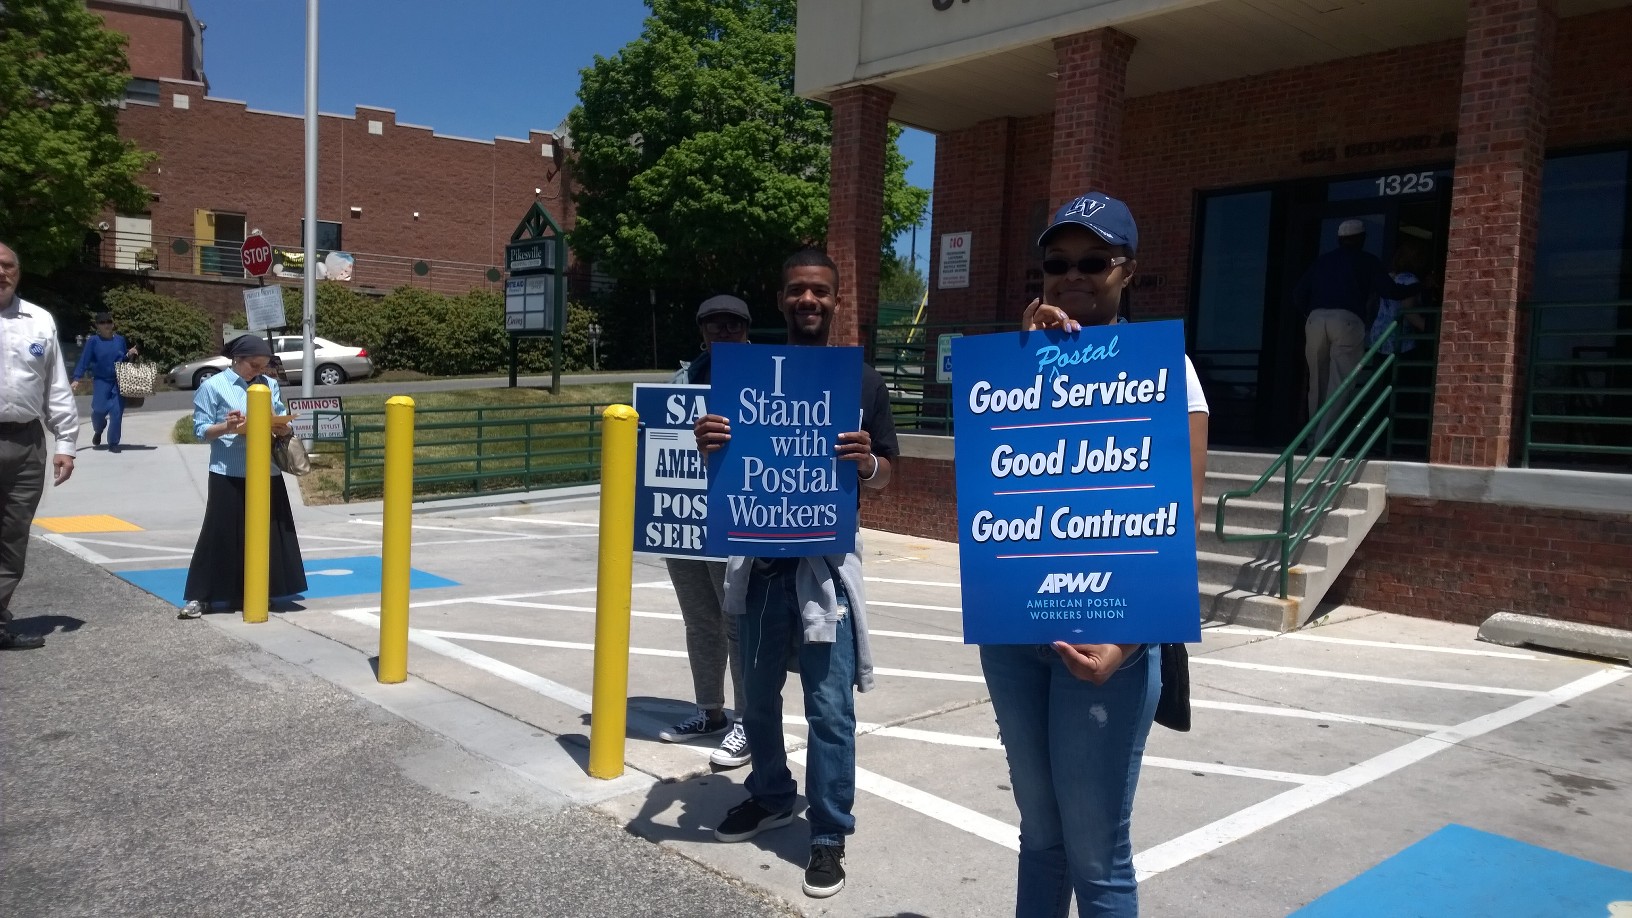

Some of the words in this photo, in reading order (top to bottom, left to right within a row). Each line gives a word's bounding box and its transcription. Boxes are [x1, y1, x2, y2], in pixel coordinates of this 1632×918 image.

[1376, 171, 1434, 196] 1325
[243, 246, 269, 265] STOP
[510, 247, 542, 260] Pikesville
[1035, 335, 1120, 373] Postal
[770, 356, 786, 397] I
[969, 374, 1043, 414] Good
[1051, 368, 1168, 409] Service!
[290, 399, 338, 410] CIMINO'S
[738, 387, 832, 427] Stand
[770, 428, 828, 457] with
[990, 439, 1066, 478] Good
[1071, 436, 1151, 475] Jobs!
[741, 456, 839, 494] Postal
[652, 492, 708, 520] POS
[726, 494, 838, 528] Workers
[971, 505, 1044, 542] Good
[1050, 502, 1178, 540] Contract!
[1037, 571, 1112, 594] APWU
[1026, 598, 1083, 609] AMERICAN
[1087, 598, 1128, 608] POSTAL
[1029, 610, 1082, 620] WORKERS
[1086, 609, 1124, 619] UNION
